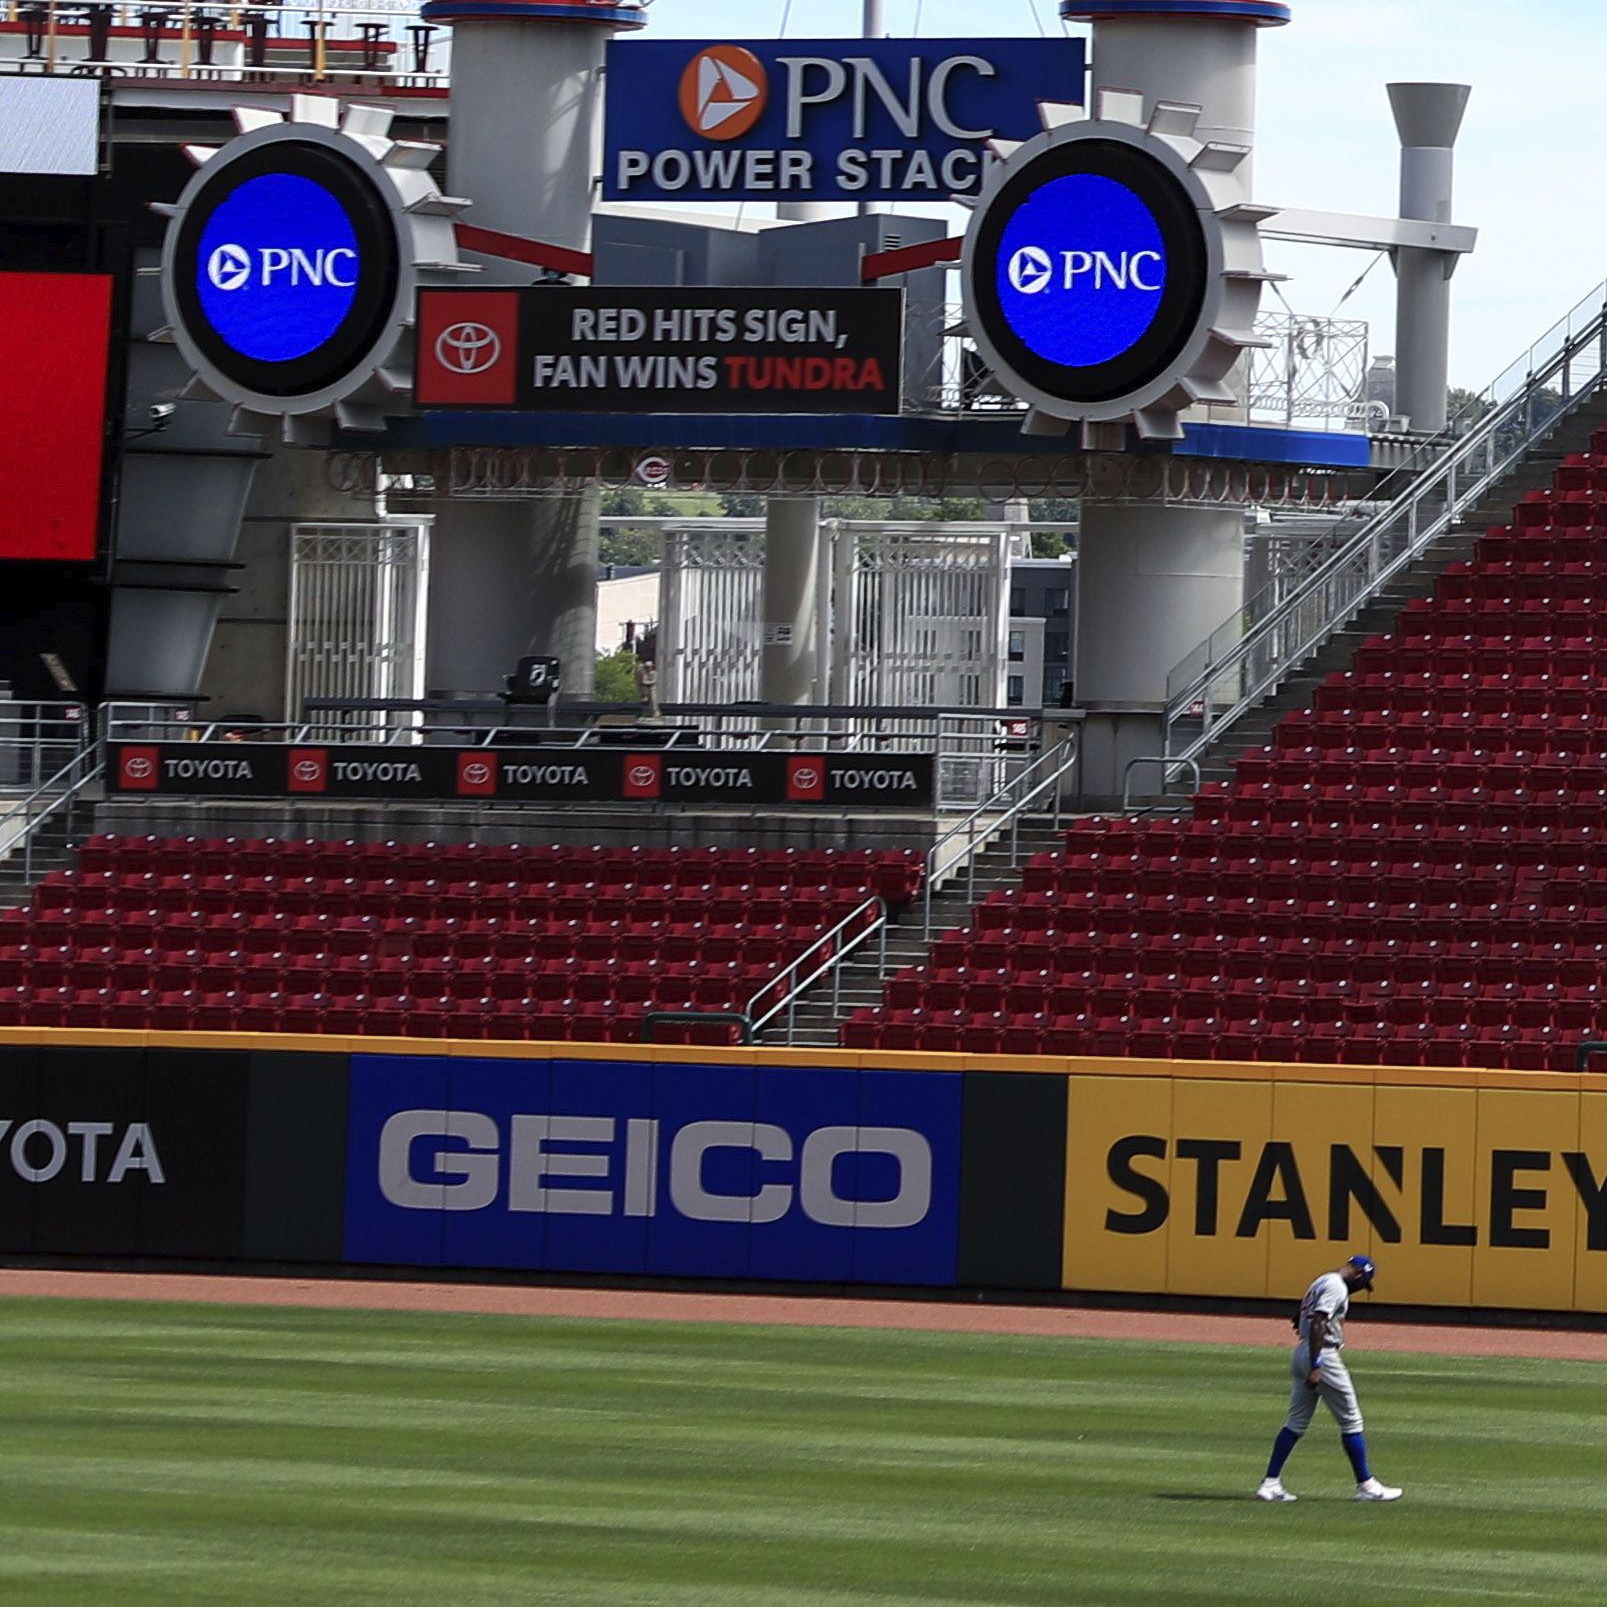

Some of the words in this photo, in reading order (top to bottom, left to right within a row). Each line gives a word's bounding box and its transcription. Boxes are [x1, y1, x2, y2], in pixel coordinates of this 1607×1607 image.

[776, 55, 996, 140] PNC
[617, 150, 812, 191] POWER
[261, 248, 356, 287] PNC
[1061, 249, 1162, 293] PNC
[571, 308, 646, 342] RED
[652, 309, 736, 344] HITS
[744, 308, 848, 349] SIGN,
[534, 354, 607, 388] FAN
[613, 354, 718, 389] WINS
[725, 356, 884, 391] TUNDRA
[165, 759, 254, 780] TOYOTA
[333, 761, 422, 783] TOYOTA
[502, 764, 589, 786] TOYOTA
[666, 766, 753, 788] TOYOTA
[831, 768, 917, 791] TOYOTA
[0, 1119, 166, 1184] OTA
[378, 1110, 932, 1228] GEICO
